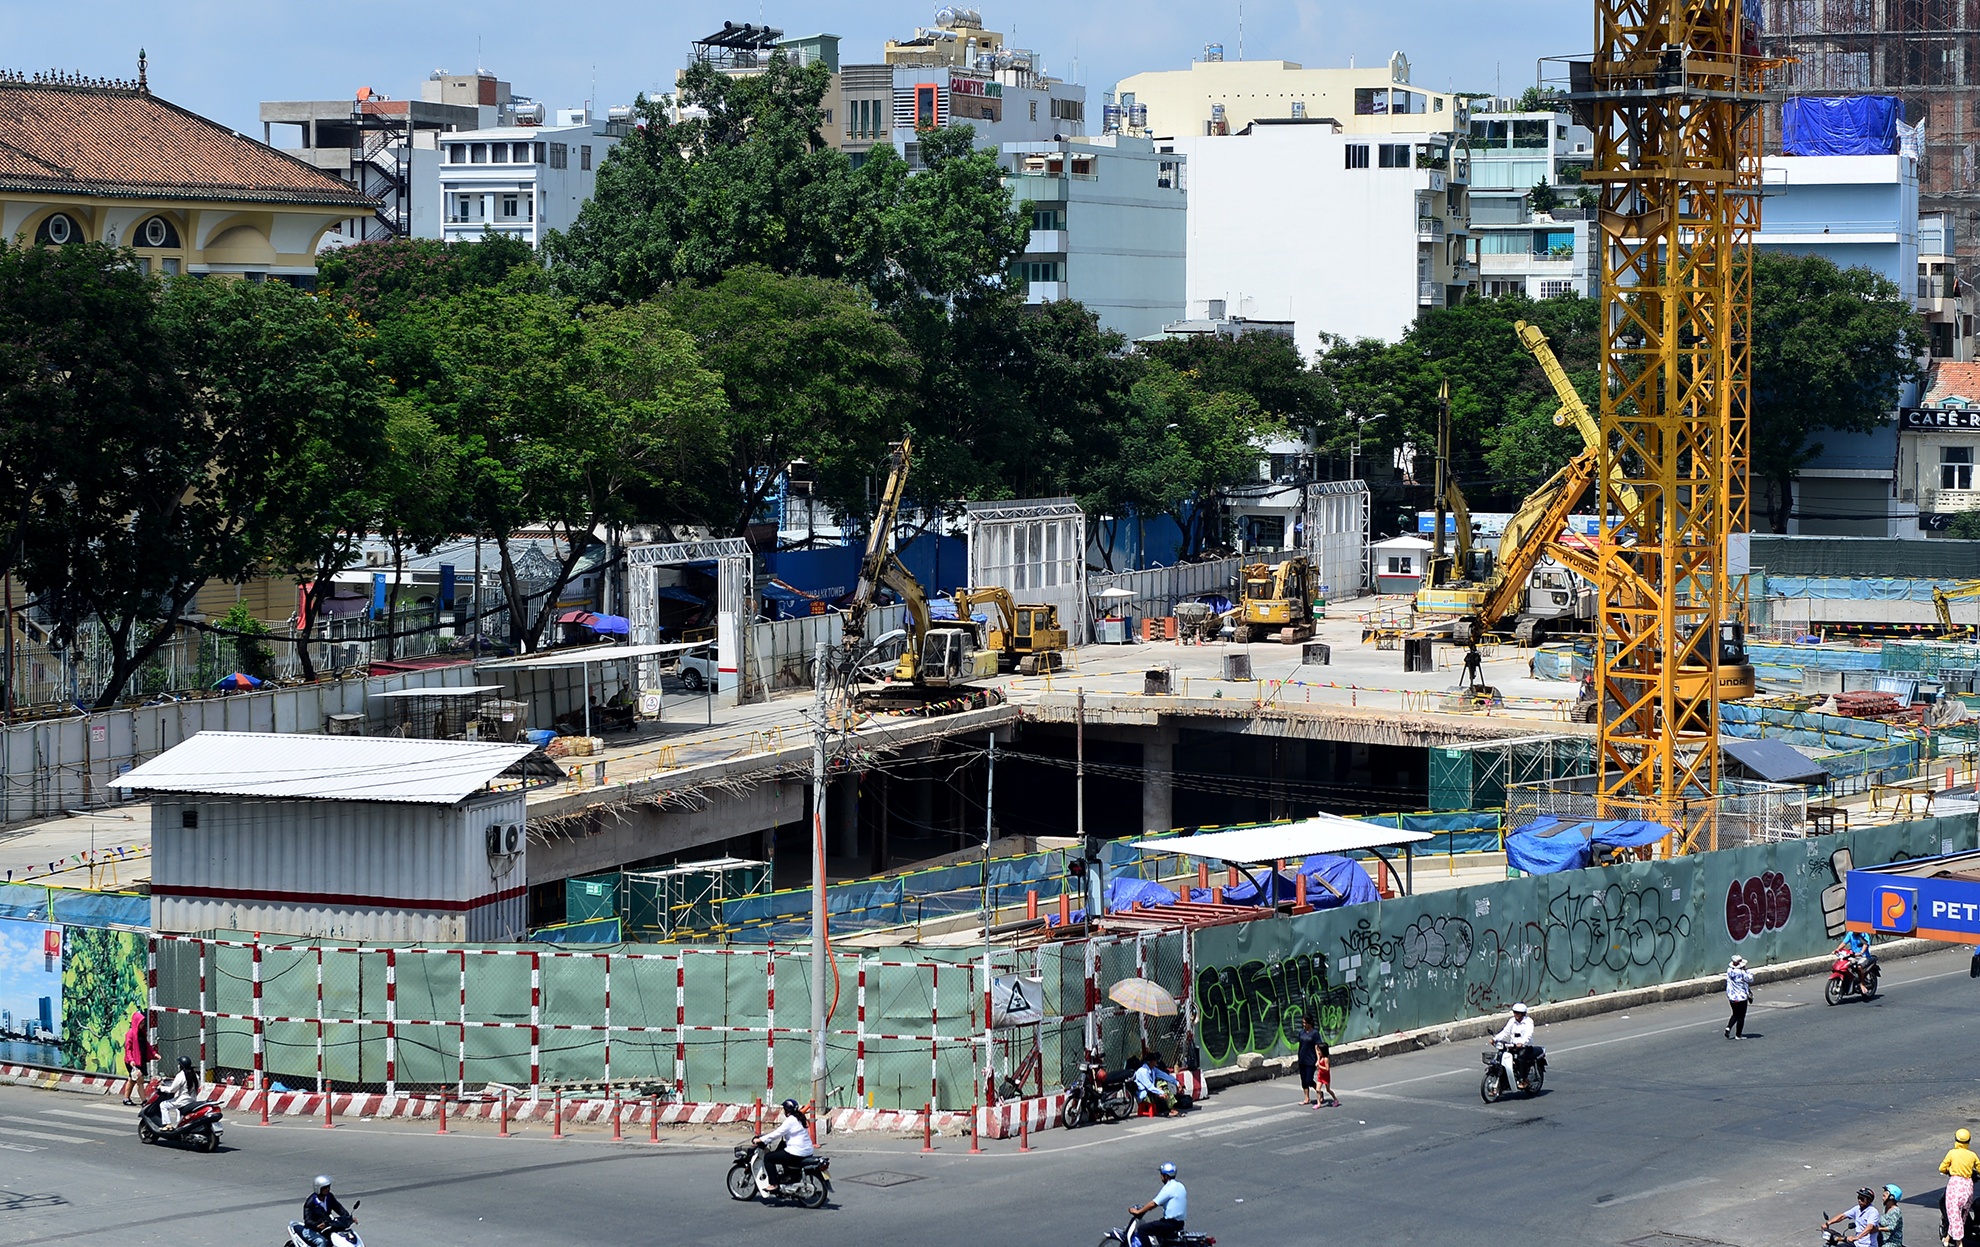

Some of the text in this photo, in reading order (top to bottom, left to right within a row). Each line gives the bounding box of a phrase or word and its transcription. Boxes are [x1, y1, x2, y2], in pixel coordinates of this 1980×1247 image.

[1562, 553, 1597, 577] HYUNDAI
[827, 585, 846, 598] TOWER
[1932, 900, 1980, 922] PET
